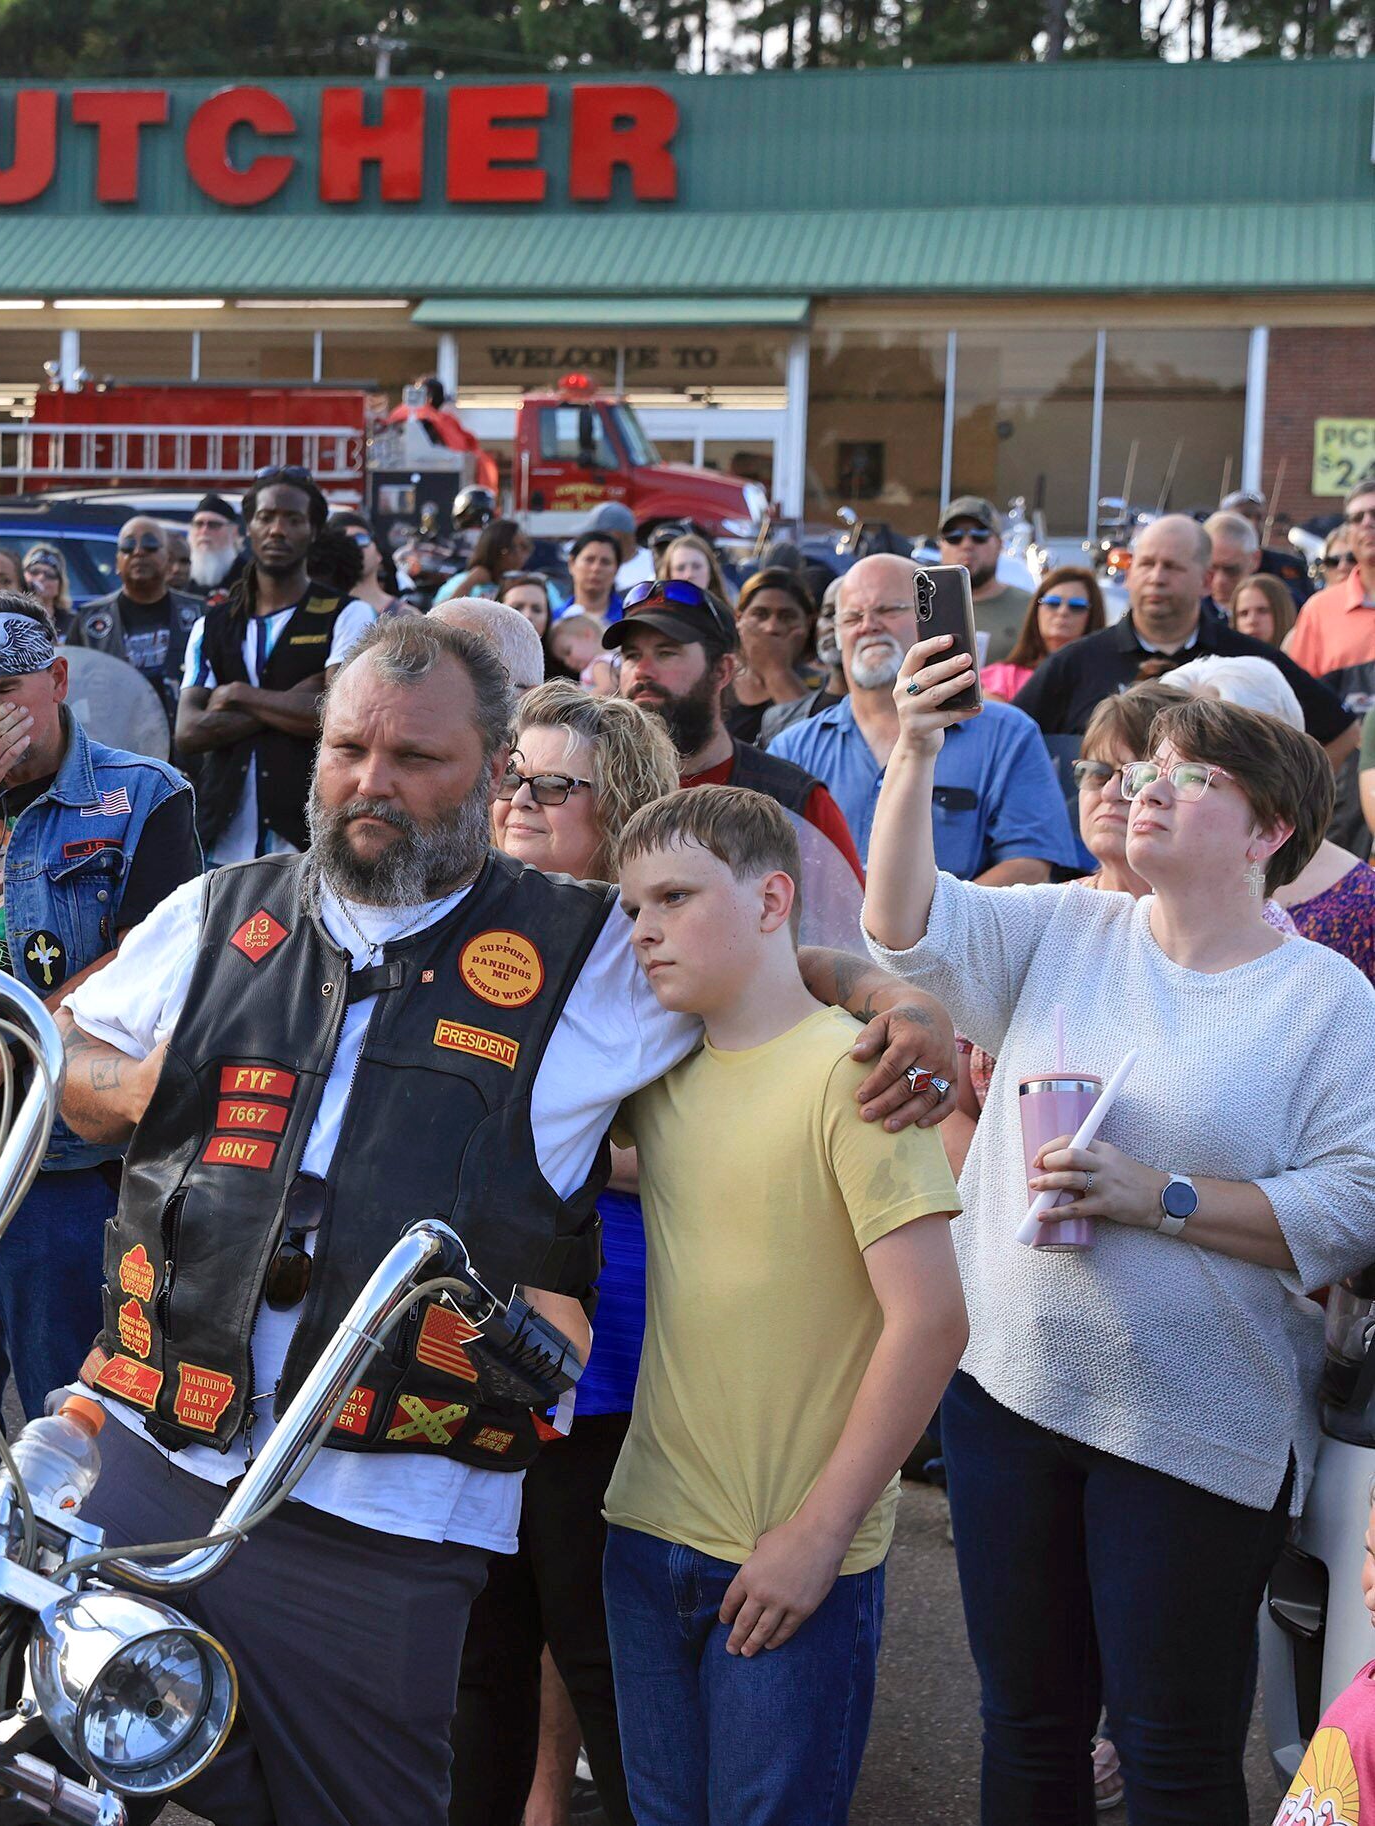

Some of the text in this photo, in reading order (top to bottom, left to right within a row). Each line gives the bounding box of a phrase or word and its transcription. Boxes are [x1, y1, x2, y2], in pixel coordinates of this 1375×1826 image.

[487, 348, 659, 368] WELCOME
[672, 349, 717, 368] TO
[1325, 428, 1375, 448] PIC
[247, 918, 270, 934] 13
[245, 933, 271, 941] Motor
[245, 940, 269, 949] Cycle
[479, 944, 531, 966] SUPPORT
[471, 956, 532, 981] BANDIDOS
[491, 969, 510, 981] MC
[466, 967, 532, 1000] WORLD WIDE
[438, 1026, 514, 1061] PRESIDENT
[234, 1069, 277, 1090] FYF
[228, 1106, 269, 1124] 7667
[217, 1141, 258, 1161] 18N7
[184, 1372, 226, 1393] BANDIDO
[184, 1388, 219, 1409] EASY
